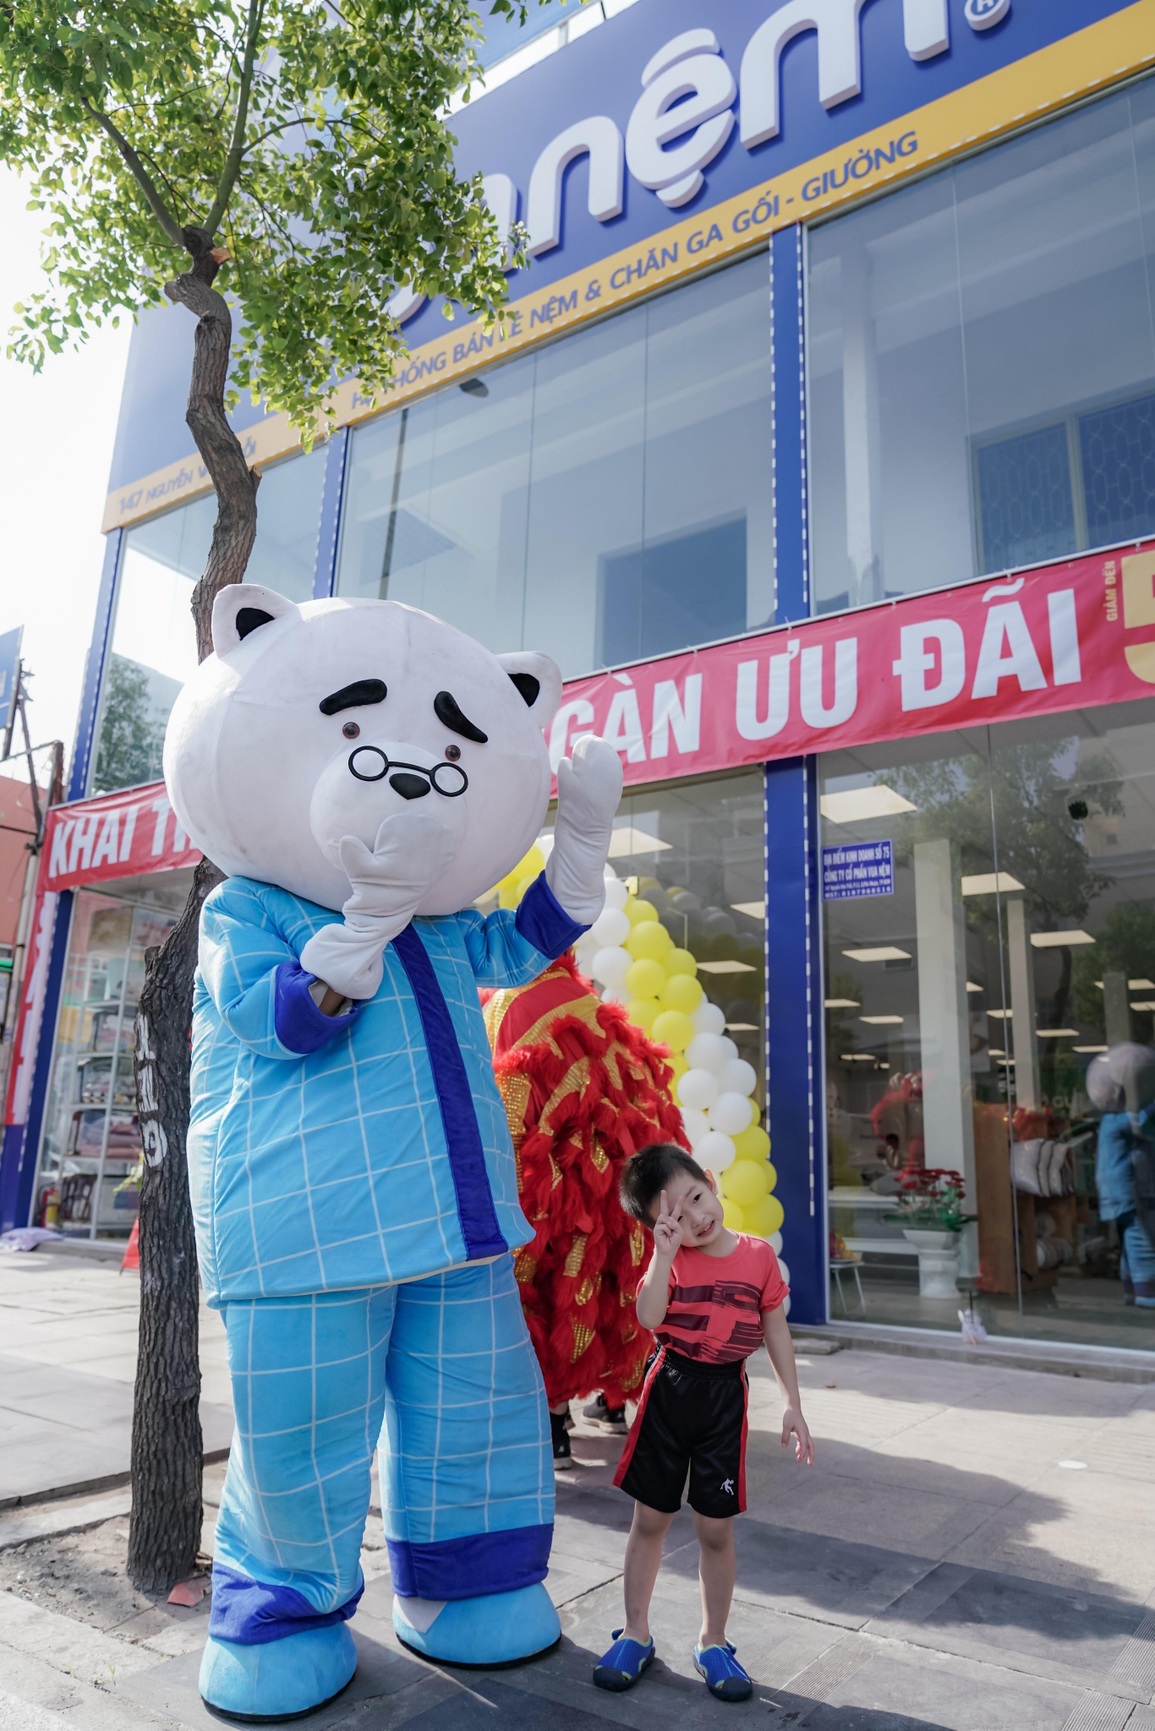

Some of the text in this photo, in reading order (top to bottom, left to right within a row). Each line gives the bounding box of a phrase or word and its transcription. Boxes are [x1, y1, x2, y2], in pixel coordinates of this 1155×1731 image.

[383, 351, 447, 394] HỐNG
[452, 328, 495, 364] BÁN
[529, 289, 578, 328] NỆM
[585, 280, 602, 301] &
[609, 242, 679, 290] CHĂN
[686, 223, 724, 254] GA
[732, 190, 780, 234] GỐI
[801, 131, 919, 202] GIƯỜNG
[119, 489, 143, 514] 147
[145, 467, 194, 503] NGUYỄN
[548, 672, 703, 776] GÀN
[735, 637, 858, 741] ƯU
[892, 577, 1082, 712] ĐÃI
[49, 805, 140, 878] KHAI
